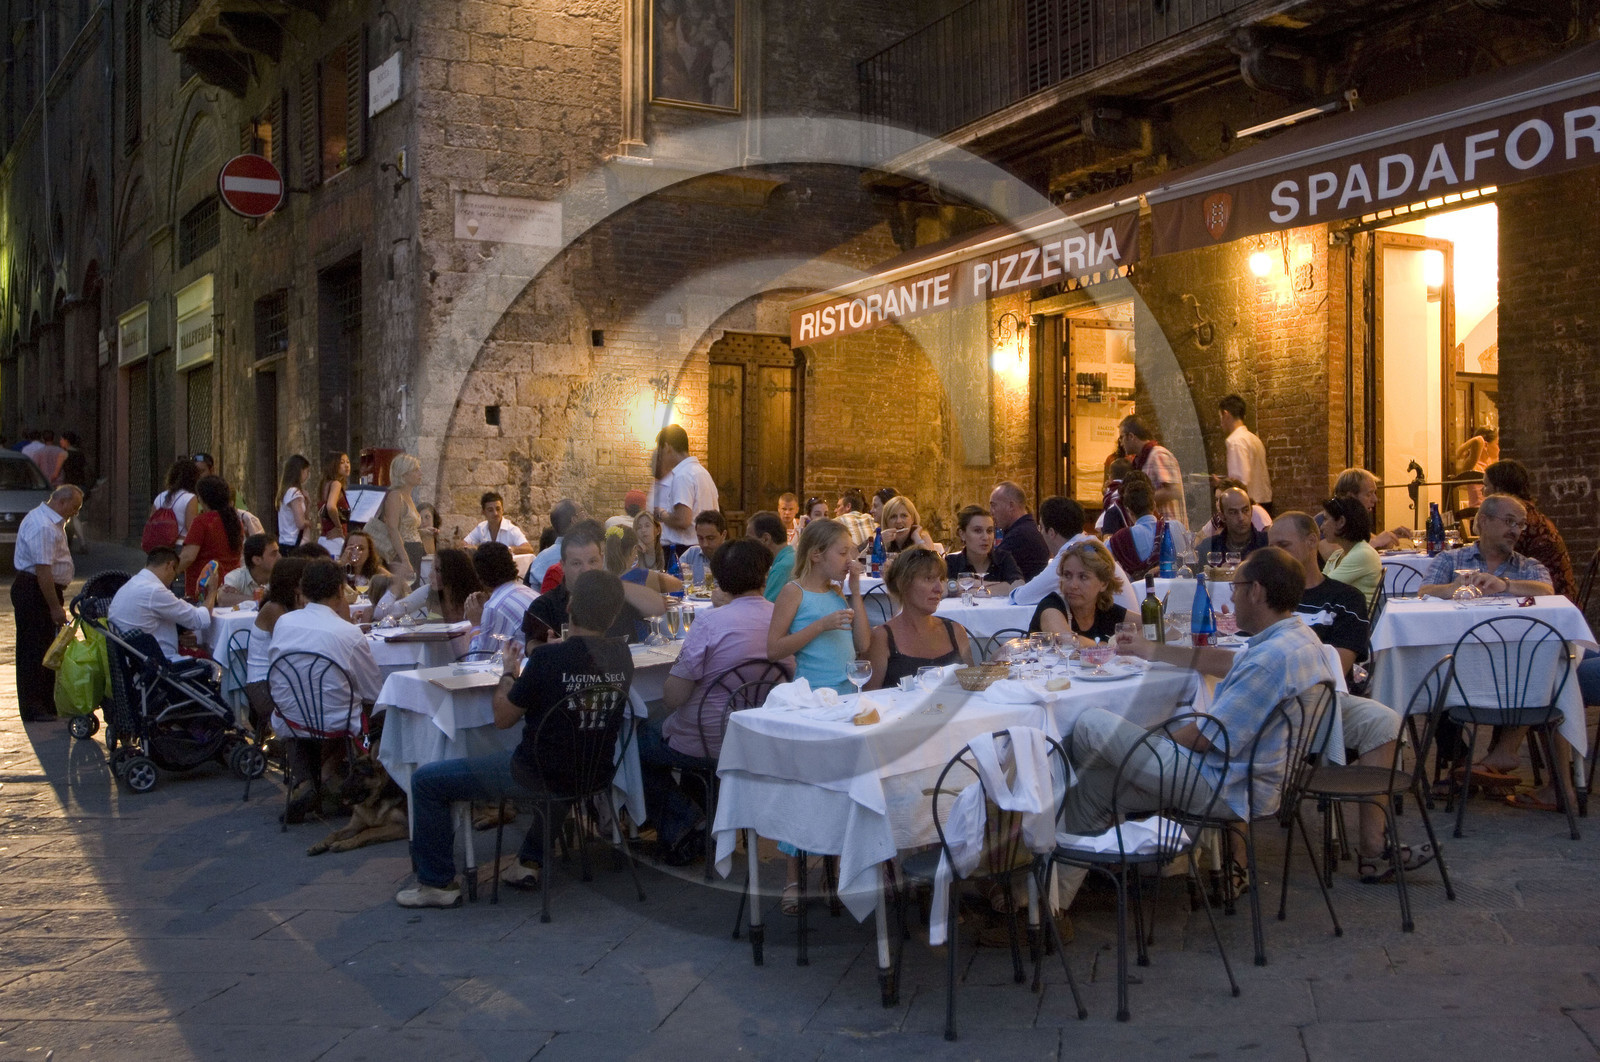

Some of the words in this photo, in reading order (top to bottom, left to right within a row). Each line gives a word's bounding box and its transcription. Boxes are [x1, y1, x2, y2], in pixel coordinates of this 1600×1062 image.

[1269, 105, 1600, 224] SPADAFOR
[799, 273, 950, 341] RISTORANTE
[973, 226, 1121, 297] PIZZERIA
